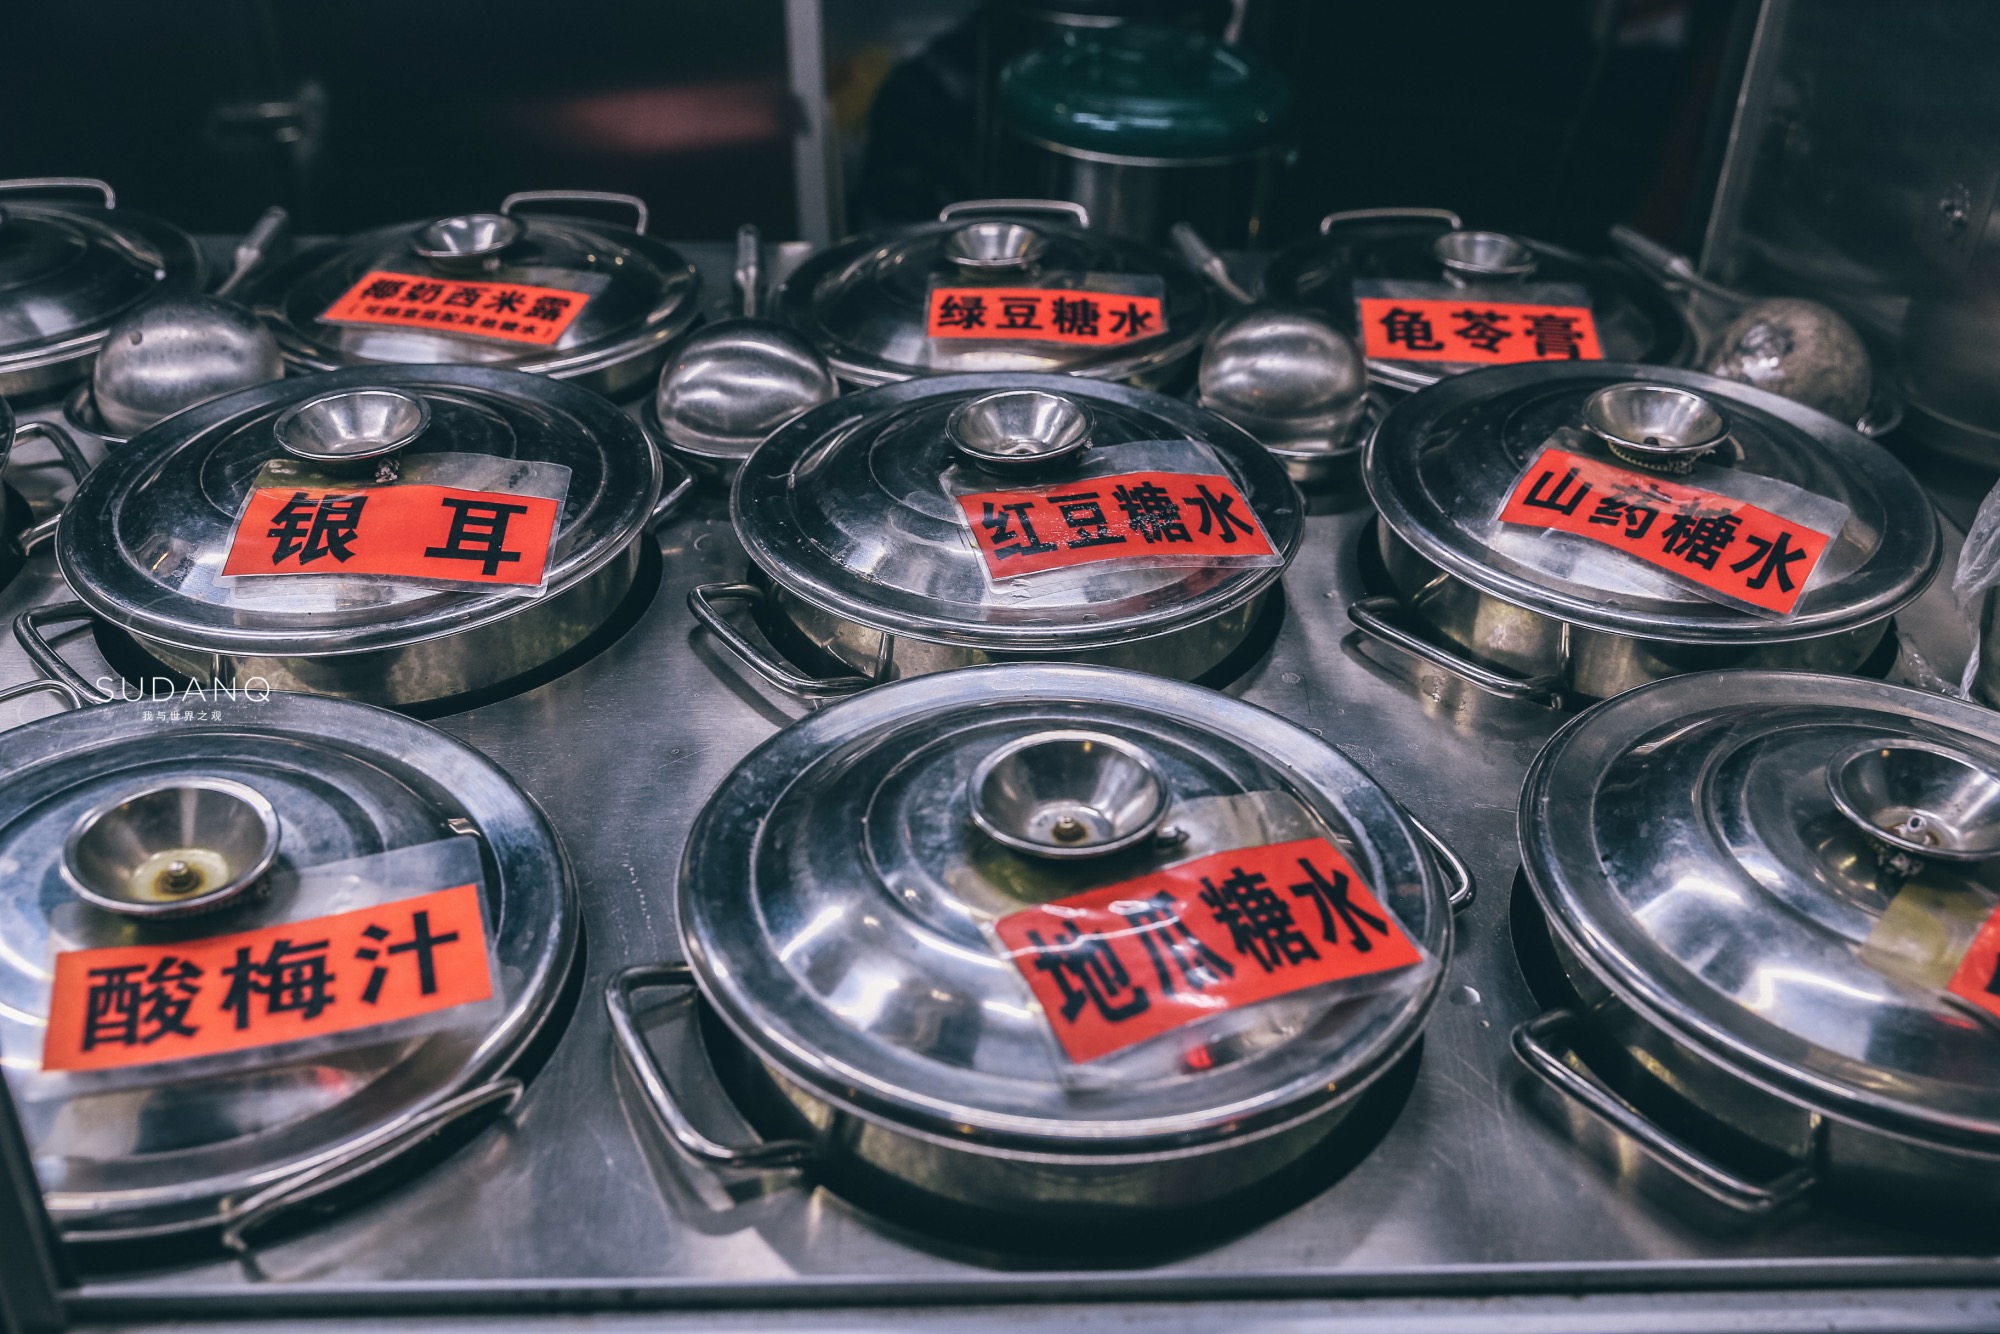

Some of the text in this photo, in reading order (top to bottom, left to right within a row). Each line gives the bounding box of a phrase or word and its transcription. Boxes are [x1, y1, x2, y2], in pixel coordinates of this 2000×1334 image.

[938, 295, 1153, 337] 绿豆糖水
[1380, 307, 1583, 360] 龟苓膏
[267, 492, 527, 575] 银耳
[982, 481, 1254, 560] 红豆糖水
[1522, 467, 1807, 593] 山药糖水
[81, 909, 459, 1052] 酸梅汁
[1028, 858, 1389, 1023] 地瓜糖水
